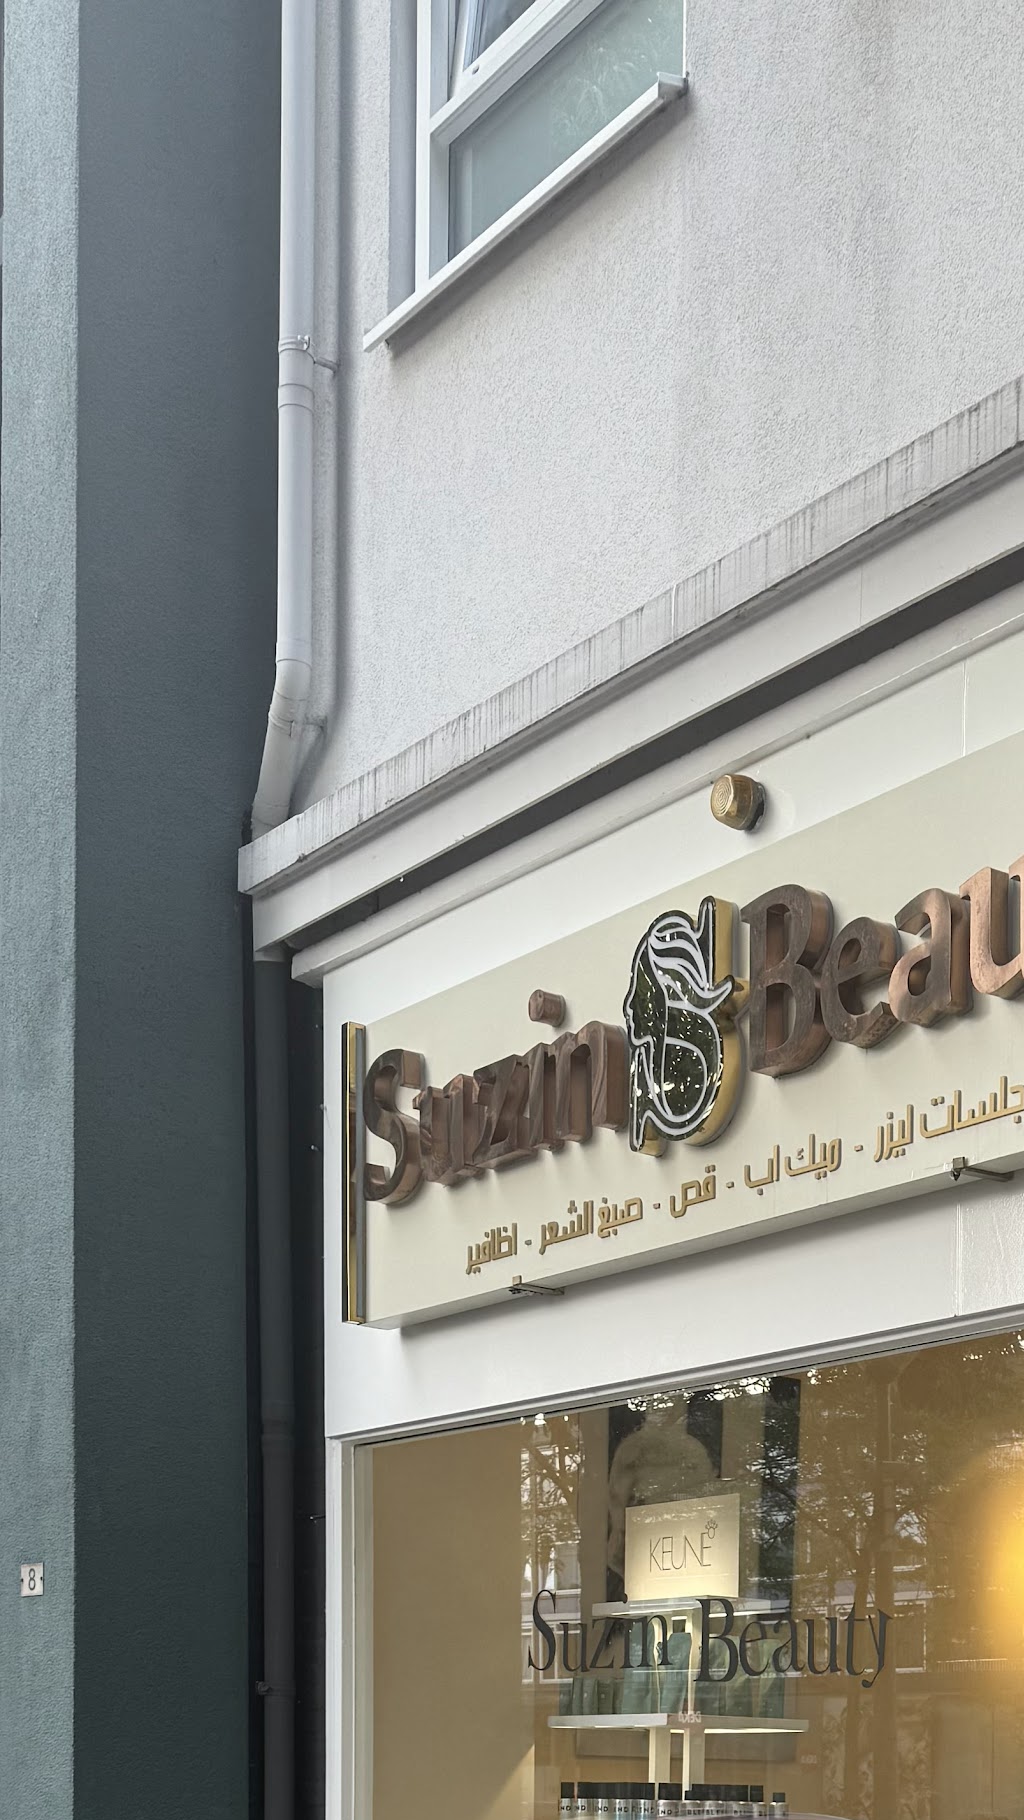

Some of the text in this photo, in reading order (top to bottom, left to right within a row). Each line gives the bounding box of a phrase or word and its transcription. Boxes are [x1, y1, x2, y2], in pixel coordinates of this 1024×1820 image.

[364, 988, 628, 1205] Suzin
[784, 1133, 842, 1180] ميك
[873, 1104, 914, 1163] ليزر
[598, 1197, 643, 1239] صبغ
[669, 1164, 716, 1218] قص
[539, 1200, 594, 1256] الشعر
[648, 1531, 712, 1573] KEUNE
[28, 1568, 36, 1591] 8
[527, 1589, 894, 1689] Suzin Beauty
